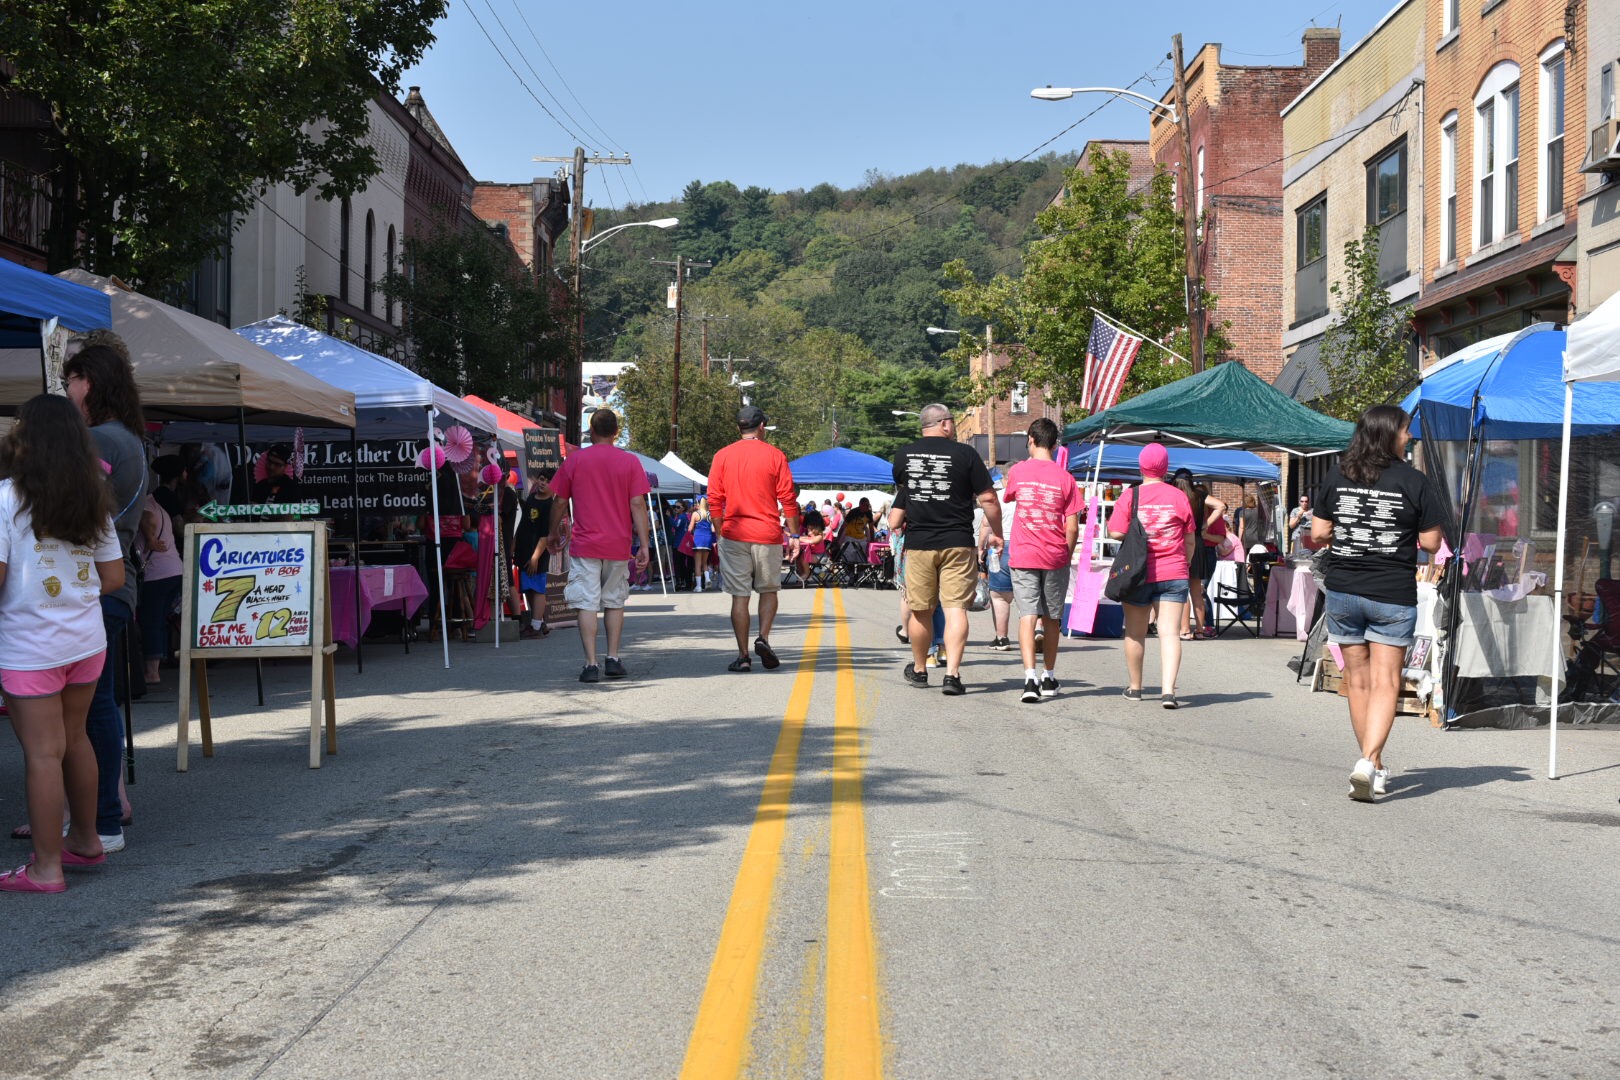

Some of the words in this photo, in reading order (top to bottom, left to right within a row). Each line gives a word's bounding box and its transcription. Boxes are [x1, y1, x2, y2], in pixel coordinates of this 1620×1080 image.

[376, 472, 394, 482] The
[383, 493, 427, 508] Goods
[216, 503, 320, 516] CARICATURES
[200, 538, 305, 577] CARICATURES
[264, 567, 275, 576] BY
[278, 566, 301, 576] BOB
[253, 585, 262, 596] A
[264, 584, 286, 595] HEAD
[246, 596, 266, 604] BLACK
[289, 617, 308, 625] FULL
[200, 624, 225, 636] LET
[228, 623, 247, 634] ME
[199, 635, 232, 647] DRAW
[234, 634, 253, 646] YOU
